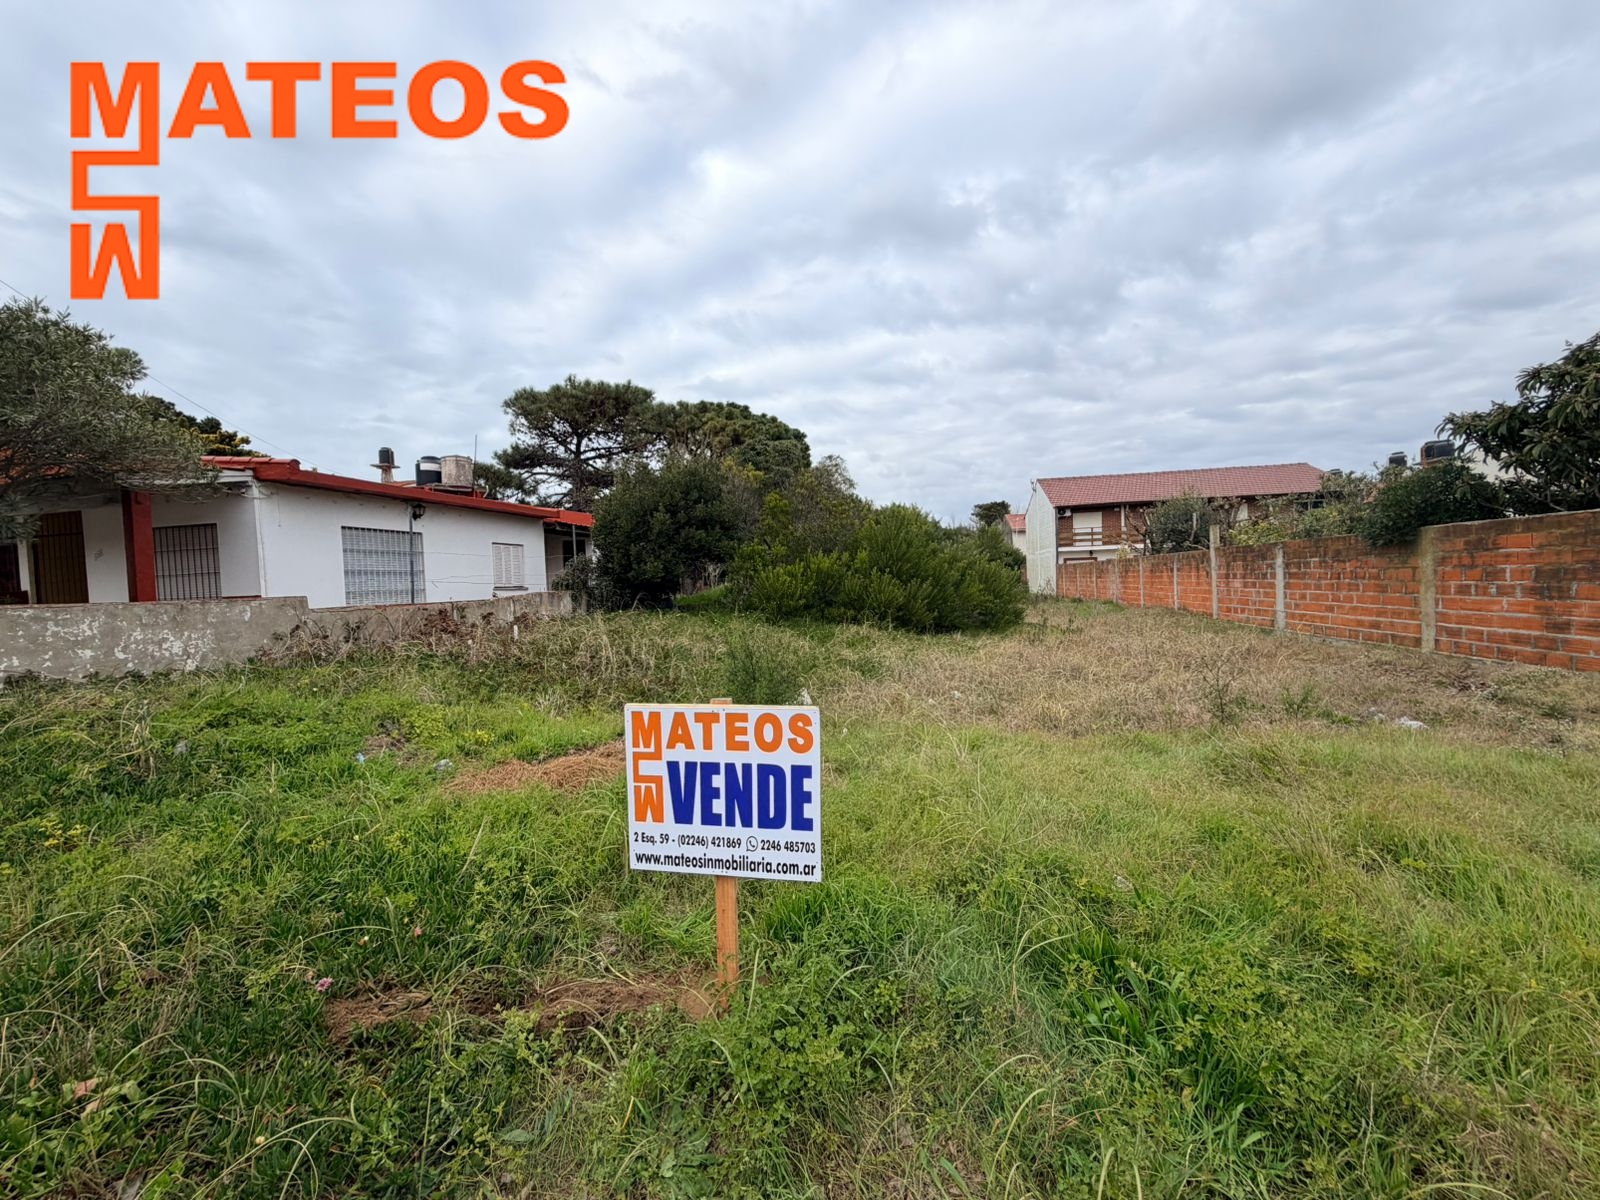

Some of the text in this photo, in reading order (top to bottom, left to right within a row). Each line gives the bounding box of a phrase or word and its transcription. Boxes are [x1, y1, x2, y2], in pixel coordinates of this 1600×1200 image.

[631, 711, 814, 754] MATEOS
[666, 760, 814, 831] VENDE
[634, 832, 639, 842] 2
[641, 832, 657, 845] Esq.
[659, 833, 670, 844] 59
[677, 834, 709, 849] (02246)
[711, 836, 742, 849] 421869
[760, 839, 782, 852] 2246
[784, 841, 816, 853] 485703
[635, 852, 816, 876] www.mateosinmobiliaria.com.ar
